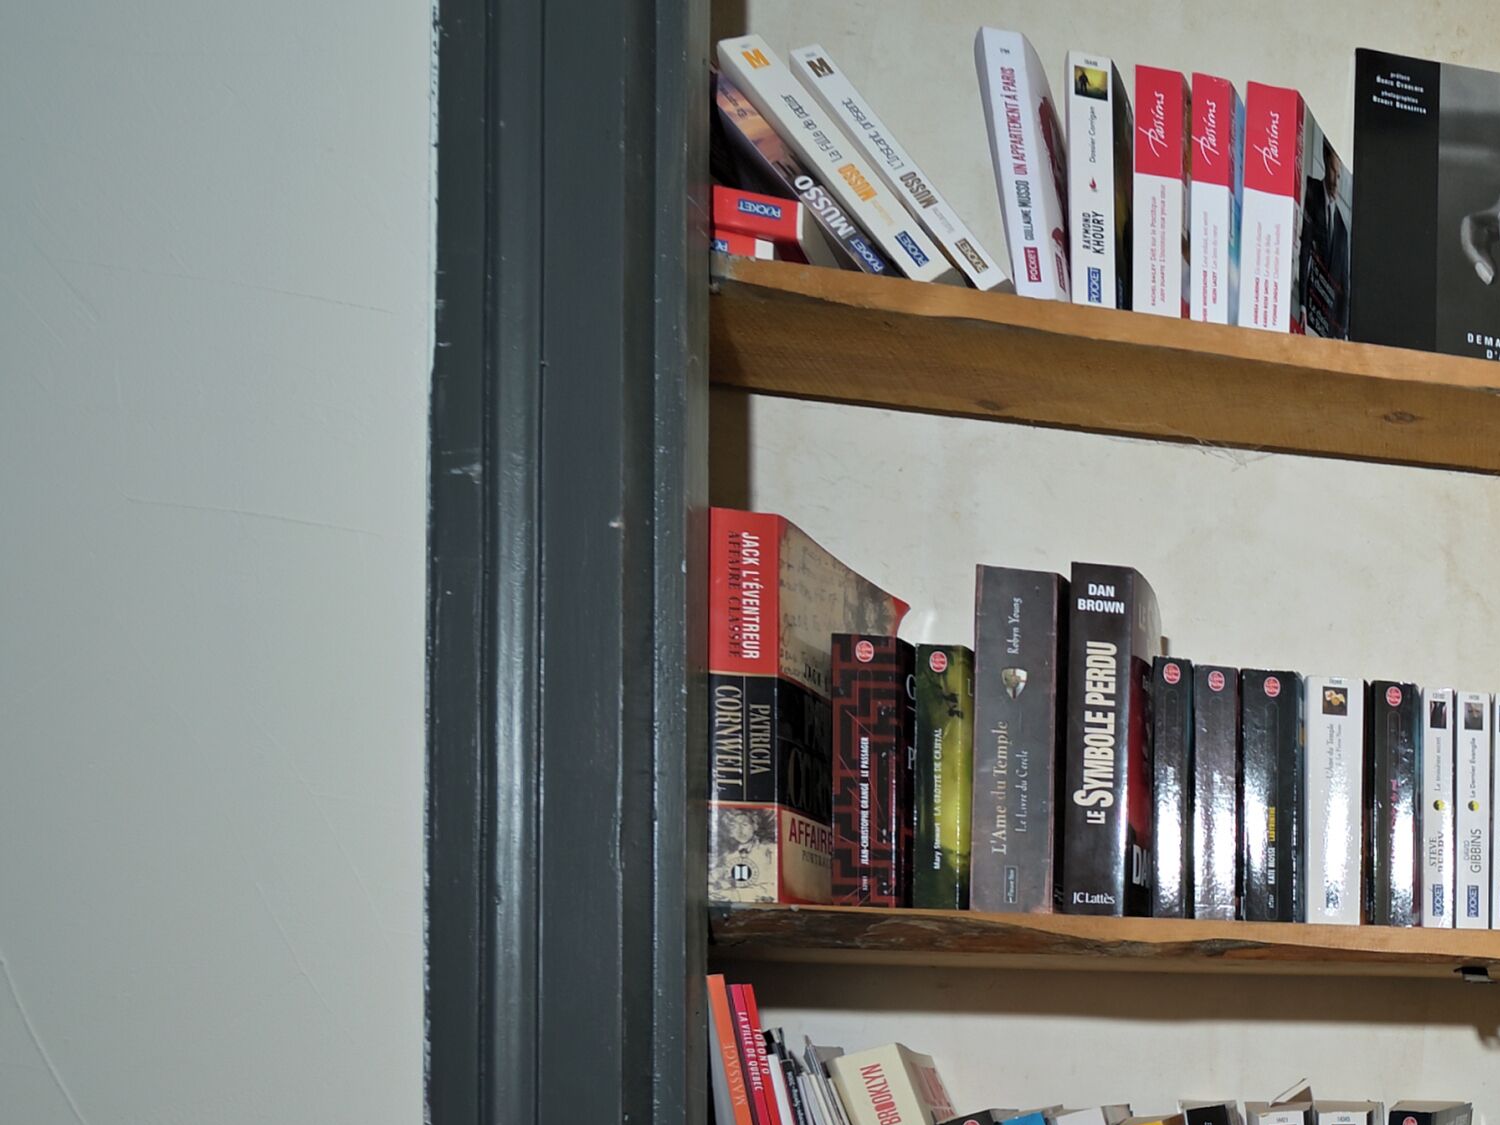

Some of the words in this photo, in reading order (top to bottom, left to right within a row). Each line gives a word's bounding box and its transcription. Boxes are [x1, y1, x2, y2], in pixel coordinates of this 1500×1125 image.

[1001, 67, 1017, 92] PARIS
[1007, 103, 1026, 162] APPARTEMENT
[1089, 106, 1097, 135] Corrigan
[1139, 92, 1165, 157] Passions
[1192, 100, 1219, 165] Passions
[1253, 111, 1281, 175] Passions
[838, 163, 878, 203] MUSSO
[1014, 163, 1028, 176] UN
[899, 172, 938, 209] MUSSO
[1016, 180, 1031, 208] MUSSO
[738, 199, 781, 218] POCKET
[794, 175, 854, 239] MUSSO
[1022, 210, 1035, 241] GUILLAUME
[1082, 212, 1091, 250] RAYMOND
[1092, 211, 1105, 255] KHOURY
[850, 237, 883, 272] POCKET
[895, 230, 930, 267] POCKET
[954, 237, 989, 273] POCKET
[1026, 248, 1040, 281] POCKET
[1088, 267, 1101, 302] POCKET
[743, 531, 759, 566] JACK
[1077, 598, 1124, 614] BROWN
[1088, 583, 1115, 597] DAN
[743, 569, 761, 659] L'ÉVENTREUR
[1008, 597, 1022, 625] Young
[1007, 627, 1022, 655] Robyn
[1086, 641, 1117, 707] PERDU
[715, 685, 743, 791] CORNWELL
[749, 703, 771, 775] PATRICIA
[860, 737, 869, 769] PASSAGER
[992, 721, 1012, 777] Temple
[1015, 750, 1028, 778] Cercle
[1073, 712, 1116, 807] SYMBOLE
[991, 779, 1007, 799] du
[1015, 779, 1028, 792] du
[934, 806, 942, 816] LA
[1015, 793, 1028, 818] Livre
[1087, 811, 1106, 824] LE
[860, 810, 869, 865] JEAN-CHRISTOPHE
[933, 822, 941, 849] Stewart
[1015, 819, 1028, 832] Le
[933, 851, 942, 869] Mary
[1429, 837, 1437, 866] STEVE
[1470, 829, 1482, 873] GIBBINS
[1433, 884, 1443, 916] POCKET
[1468, 885, 1478, 917] POCKET
[737, 1011, 748, 1022] LA
[740, 1023, 755, 1046] VILLE
[745, 1048, 757, 1059] DE
[753, 1028, 770, 1075] TORONTO
[722, 1043, 746, 1106] MASSAGE
[860, 1063, 903, 1125] BROOKLYN
